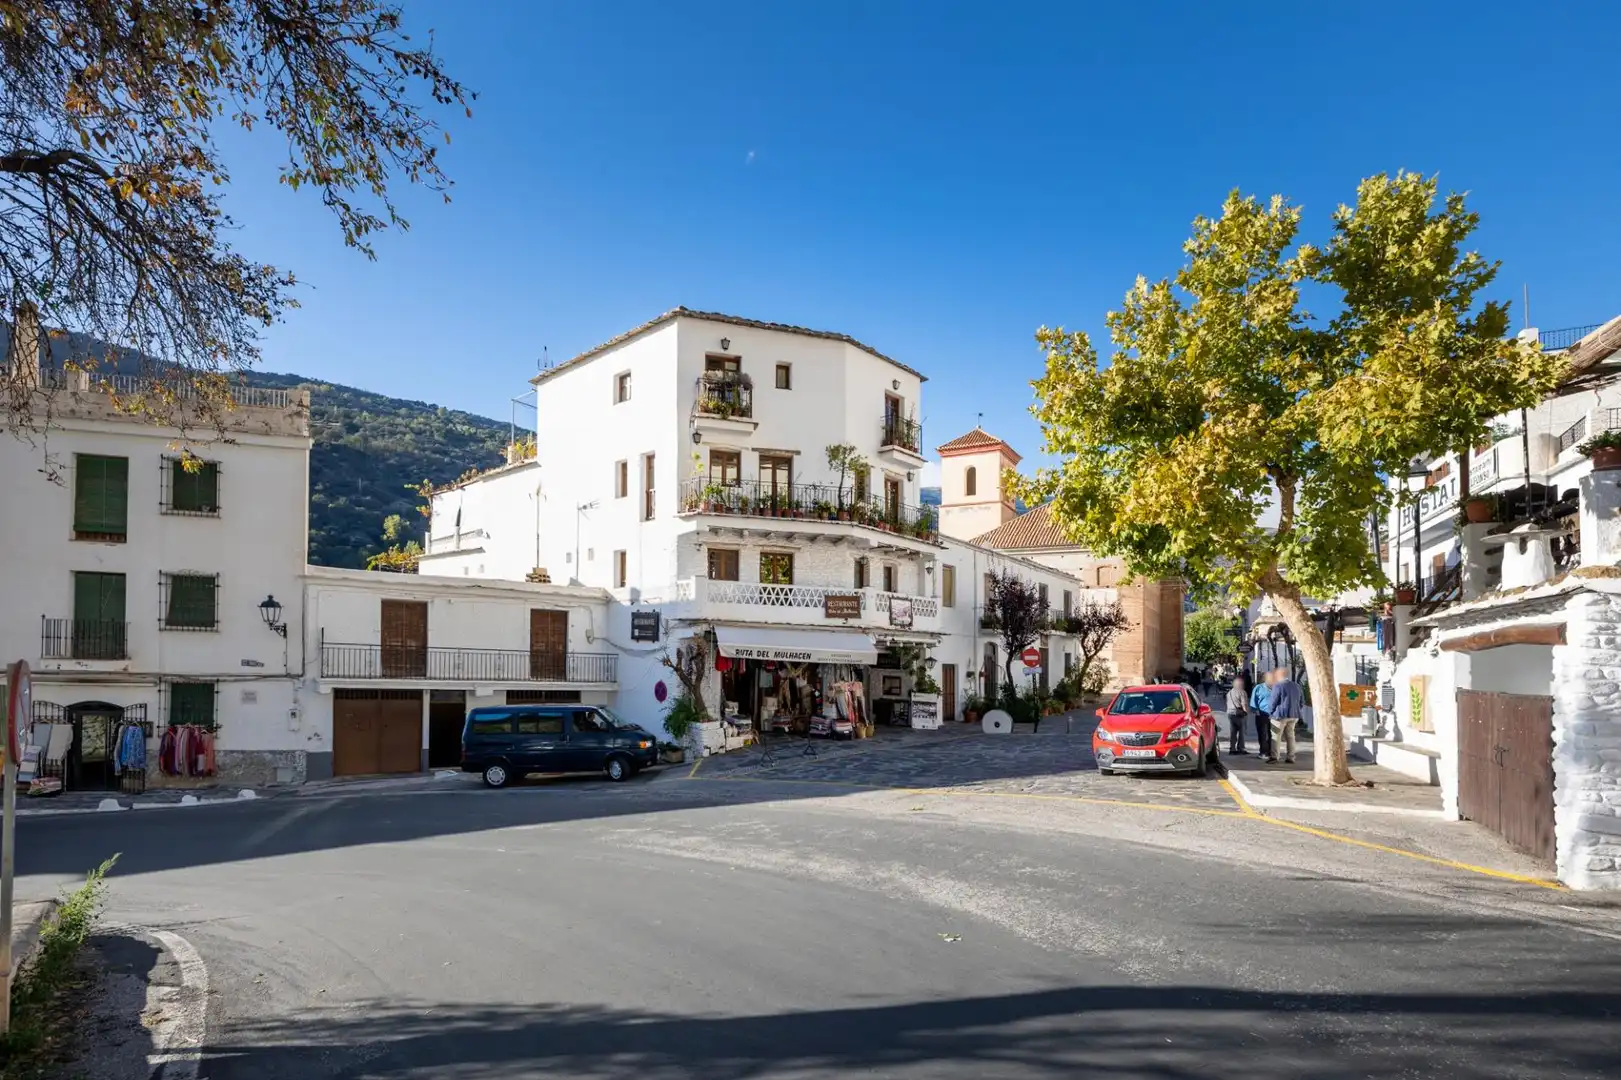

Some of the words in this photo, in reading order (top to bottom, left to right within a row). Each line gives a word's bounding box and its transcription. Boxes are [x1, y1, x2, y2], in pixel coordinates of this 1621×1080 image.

[735, 648, 753, 657] RUTA
[756, 650, 770, 658] DEL
[773, 651, 812, 660] MULHACEN
